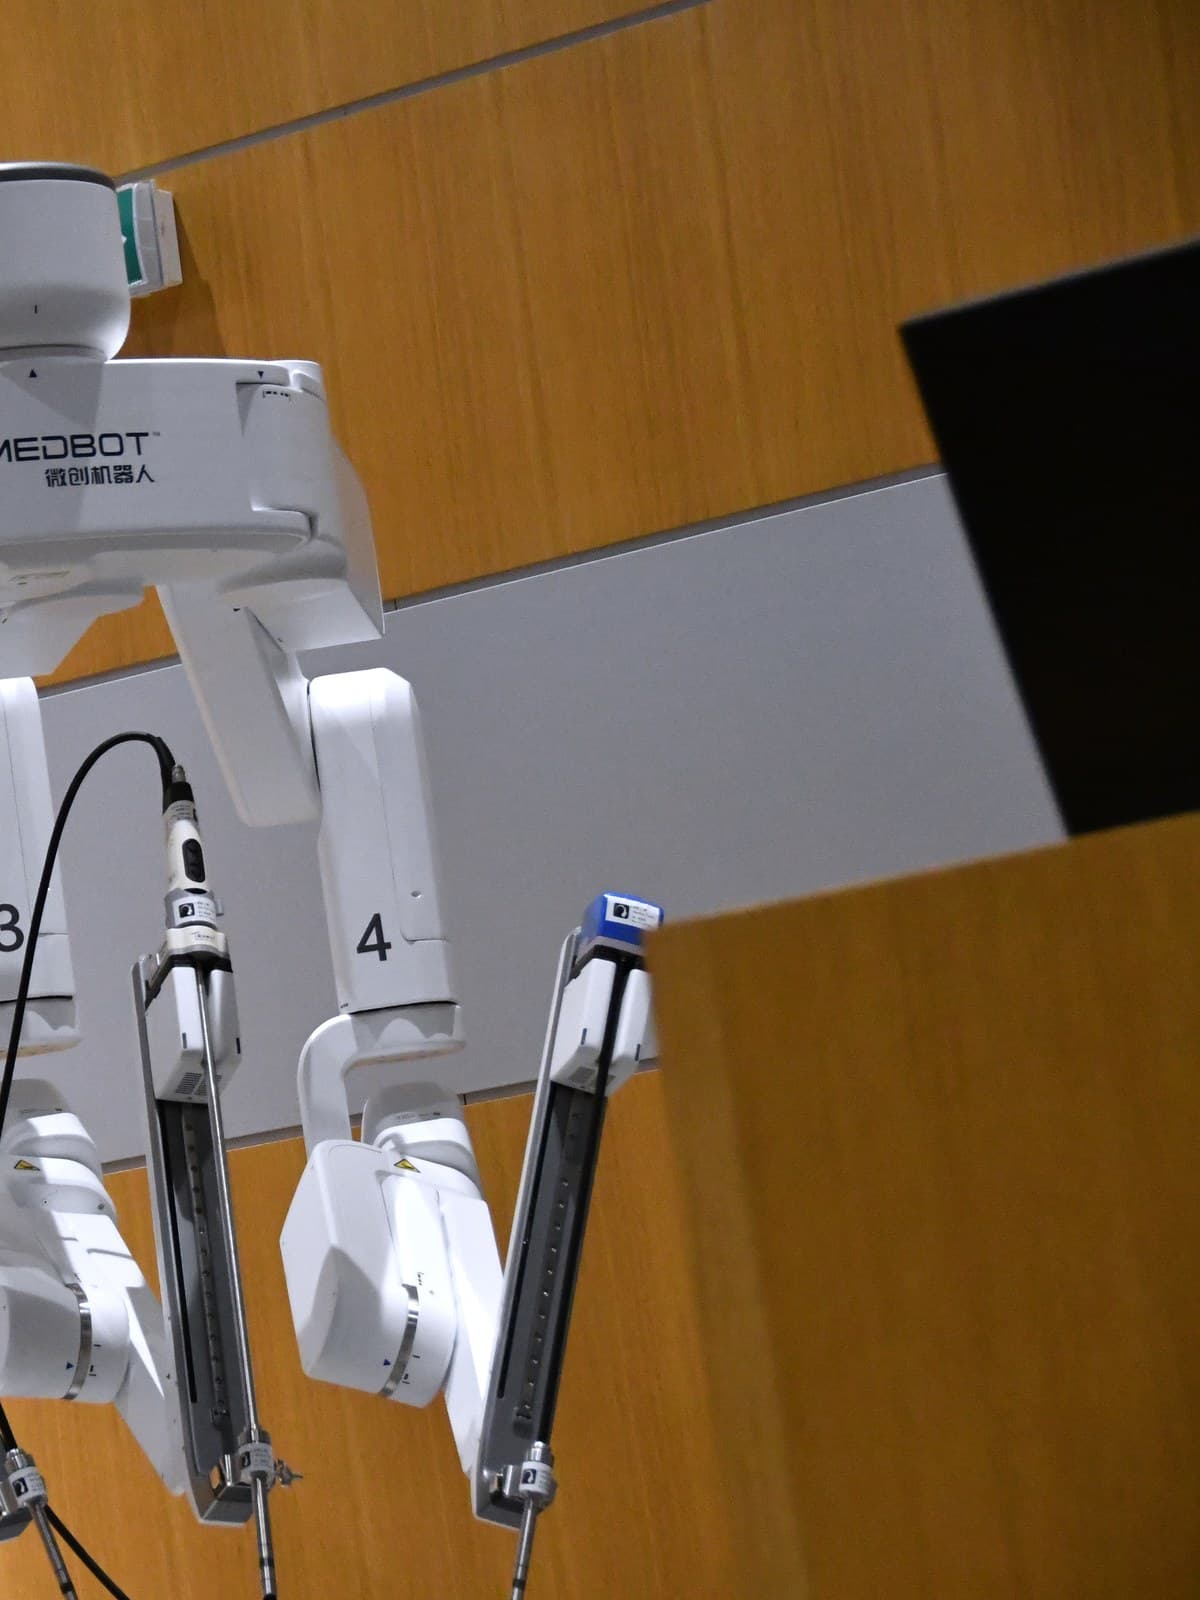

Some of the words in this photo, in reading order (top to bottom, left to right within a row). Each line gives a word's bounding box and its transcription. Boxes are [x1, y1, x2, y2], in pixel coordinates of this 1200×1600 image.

[45, 464, 155, 487] 微创机器人
[356, 913, 392, 961] 4
